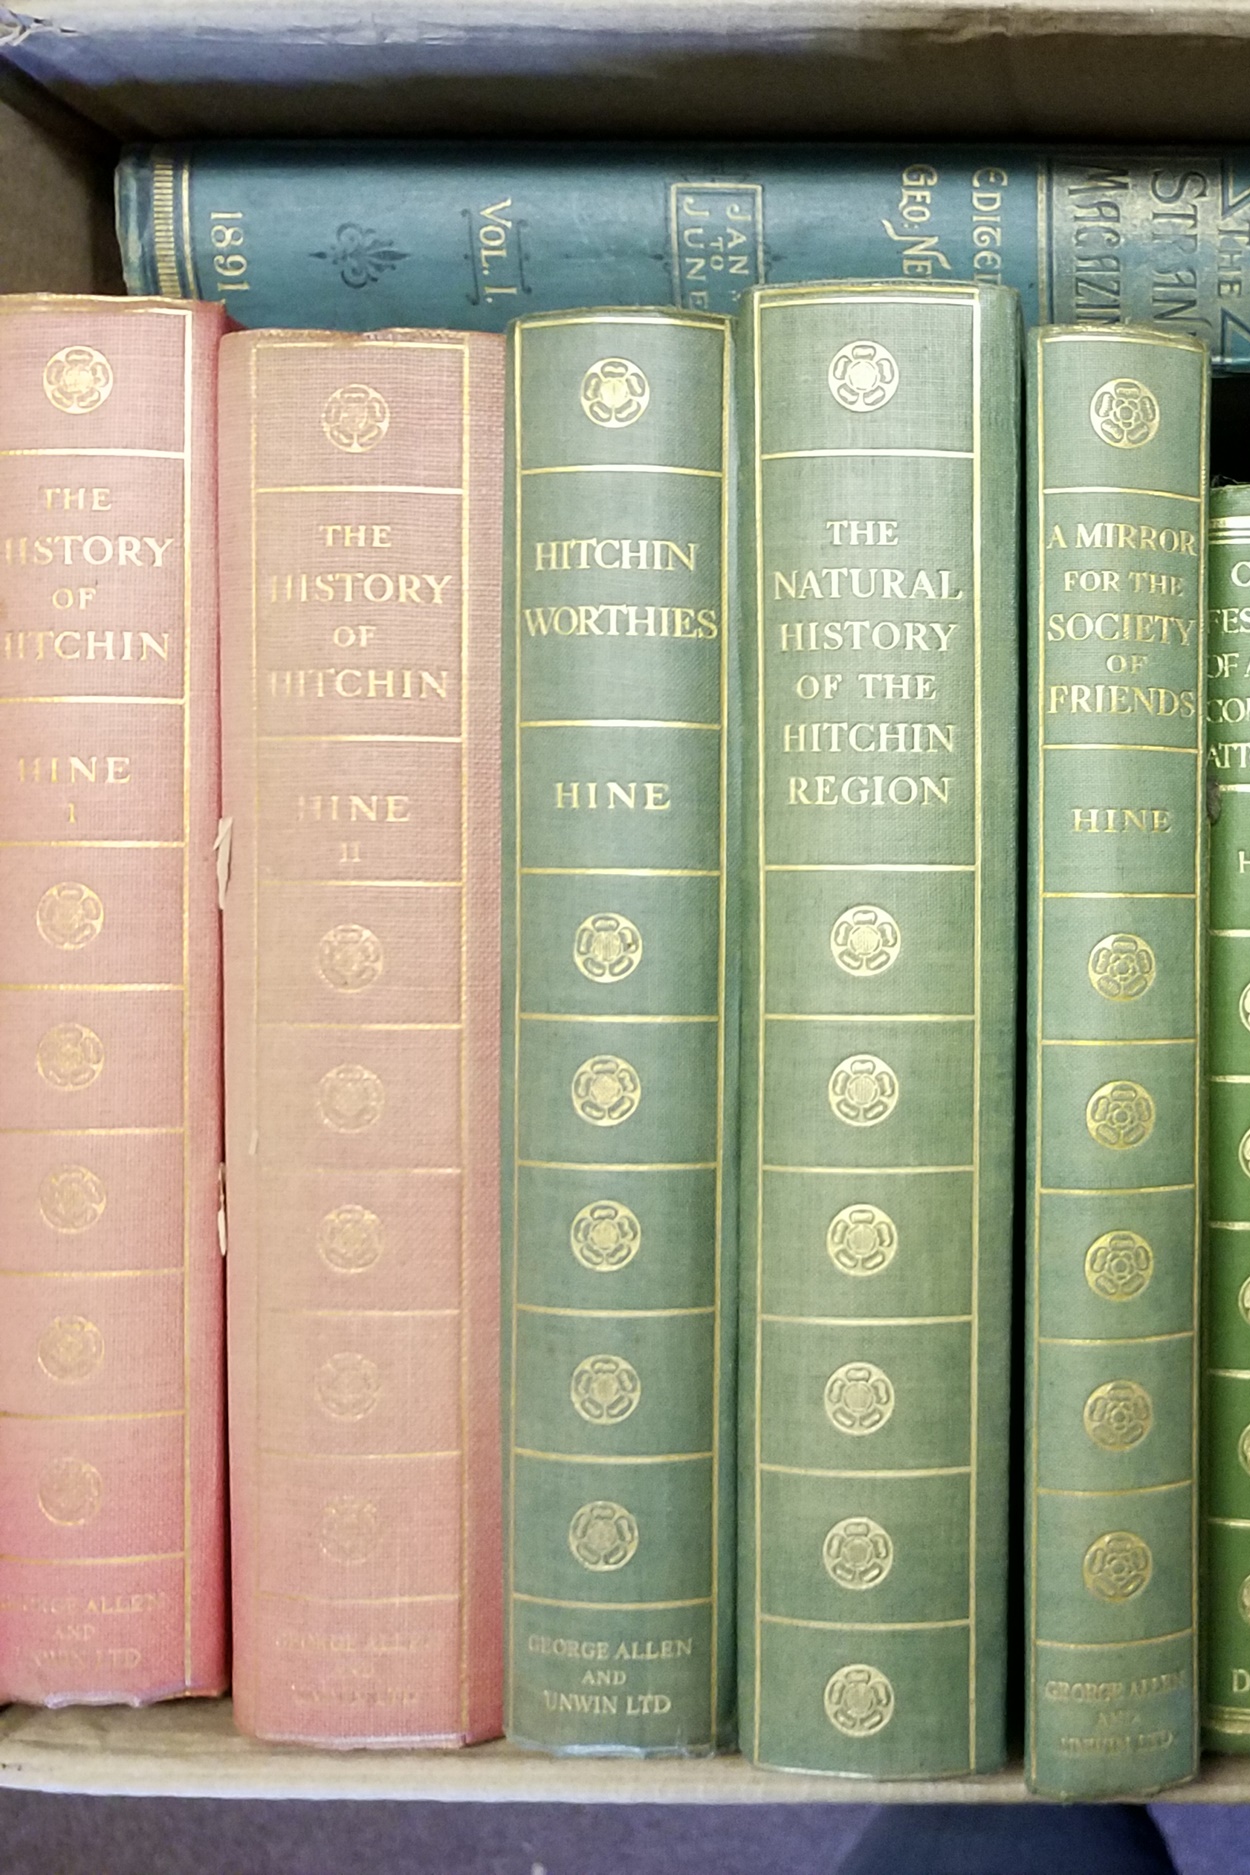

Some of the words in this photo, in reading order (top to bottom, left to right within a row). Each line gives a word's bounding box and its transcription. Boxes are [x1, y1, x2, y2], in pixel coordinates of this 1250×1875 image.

[480, 197, 512, 275] VOL.
[709, 236, 724, 271] TO
[1152, 168, 1212, 337] STRAN
[44, 487, 112, 511] THE
[320, 525, 392, 548] THE
[826, 520, 898, 546] THE
[1046, 524, 1068, 549] A
[1075, 522, 1197, 557] MIRROR
[535, 539, 698, 572] HITCHIN
[271, 573, 453, 604] HISTORY
[774, 569, 963, 600] NATURAL
[1064, 570, 1121, 593] FOR
[1128, 572, 1184, 597] THE
[52, 587, 97, 610] OF
[333, 625, 377, 648] OF
[524, 604, 719, 640] WORTHIES
[780, 621, 958, 652] HISTORY
[1047, 612, 1195, 647] SOCIETY
[1106, 655, 1148, 674] OF
[270, 668, 449, 699] HITCHIN
[796, 674, 843, 700] OF
[859, 673, 937, 700] THE
[1047, 684, 1196, 719] FRIENDS
[783, 723, 954, 753] HITCHIN
[18, 756, 131, 784] HINE
[555, 782, 671, 811] HINE
[788, 776, 951, 806] REGION
[1071, 808, 1172, 834] HINE
[528, 1635, 610, 1660] GEORGE
[615, 1632, 692, 1660] ALLEN
[581, 1669, 626, 1686] AND
[544, 1690, 617, 1714] UNWIN
[626, 1694, 672, 1715] LTD
